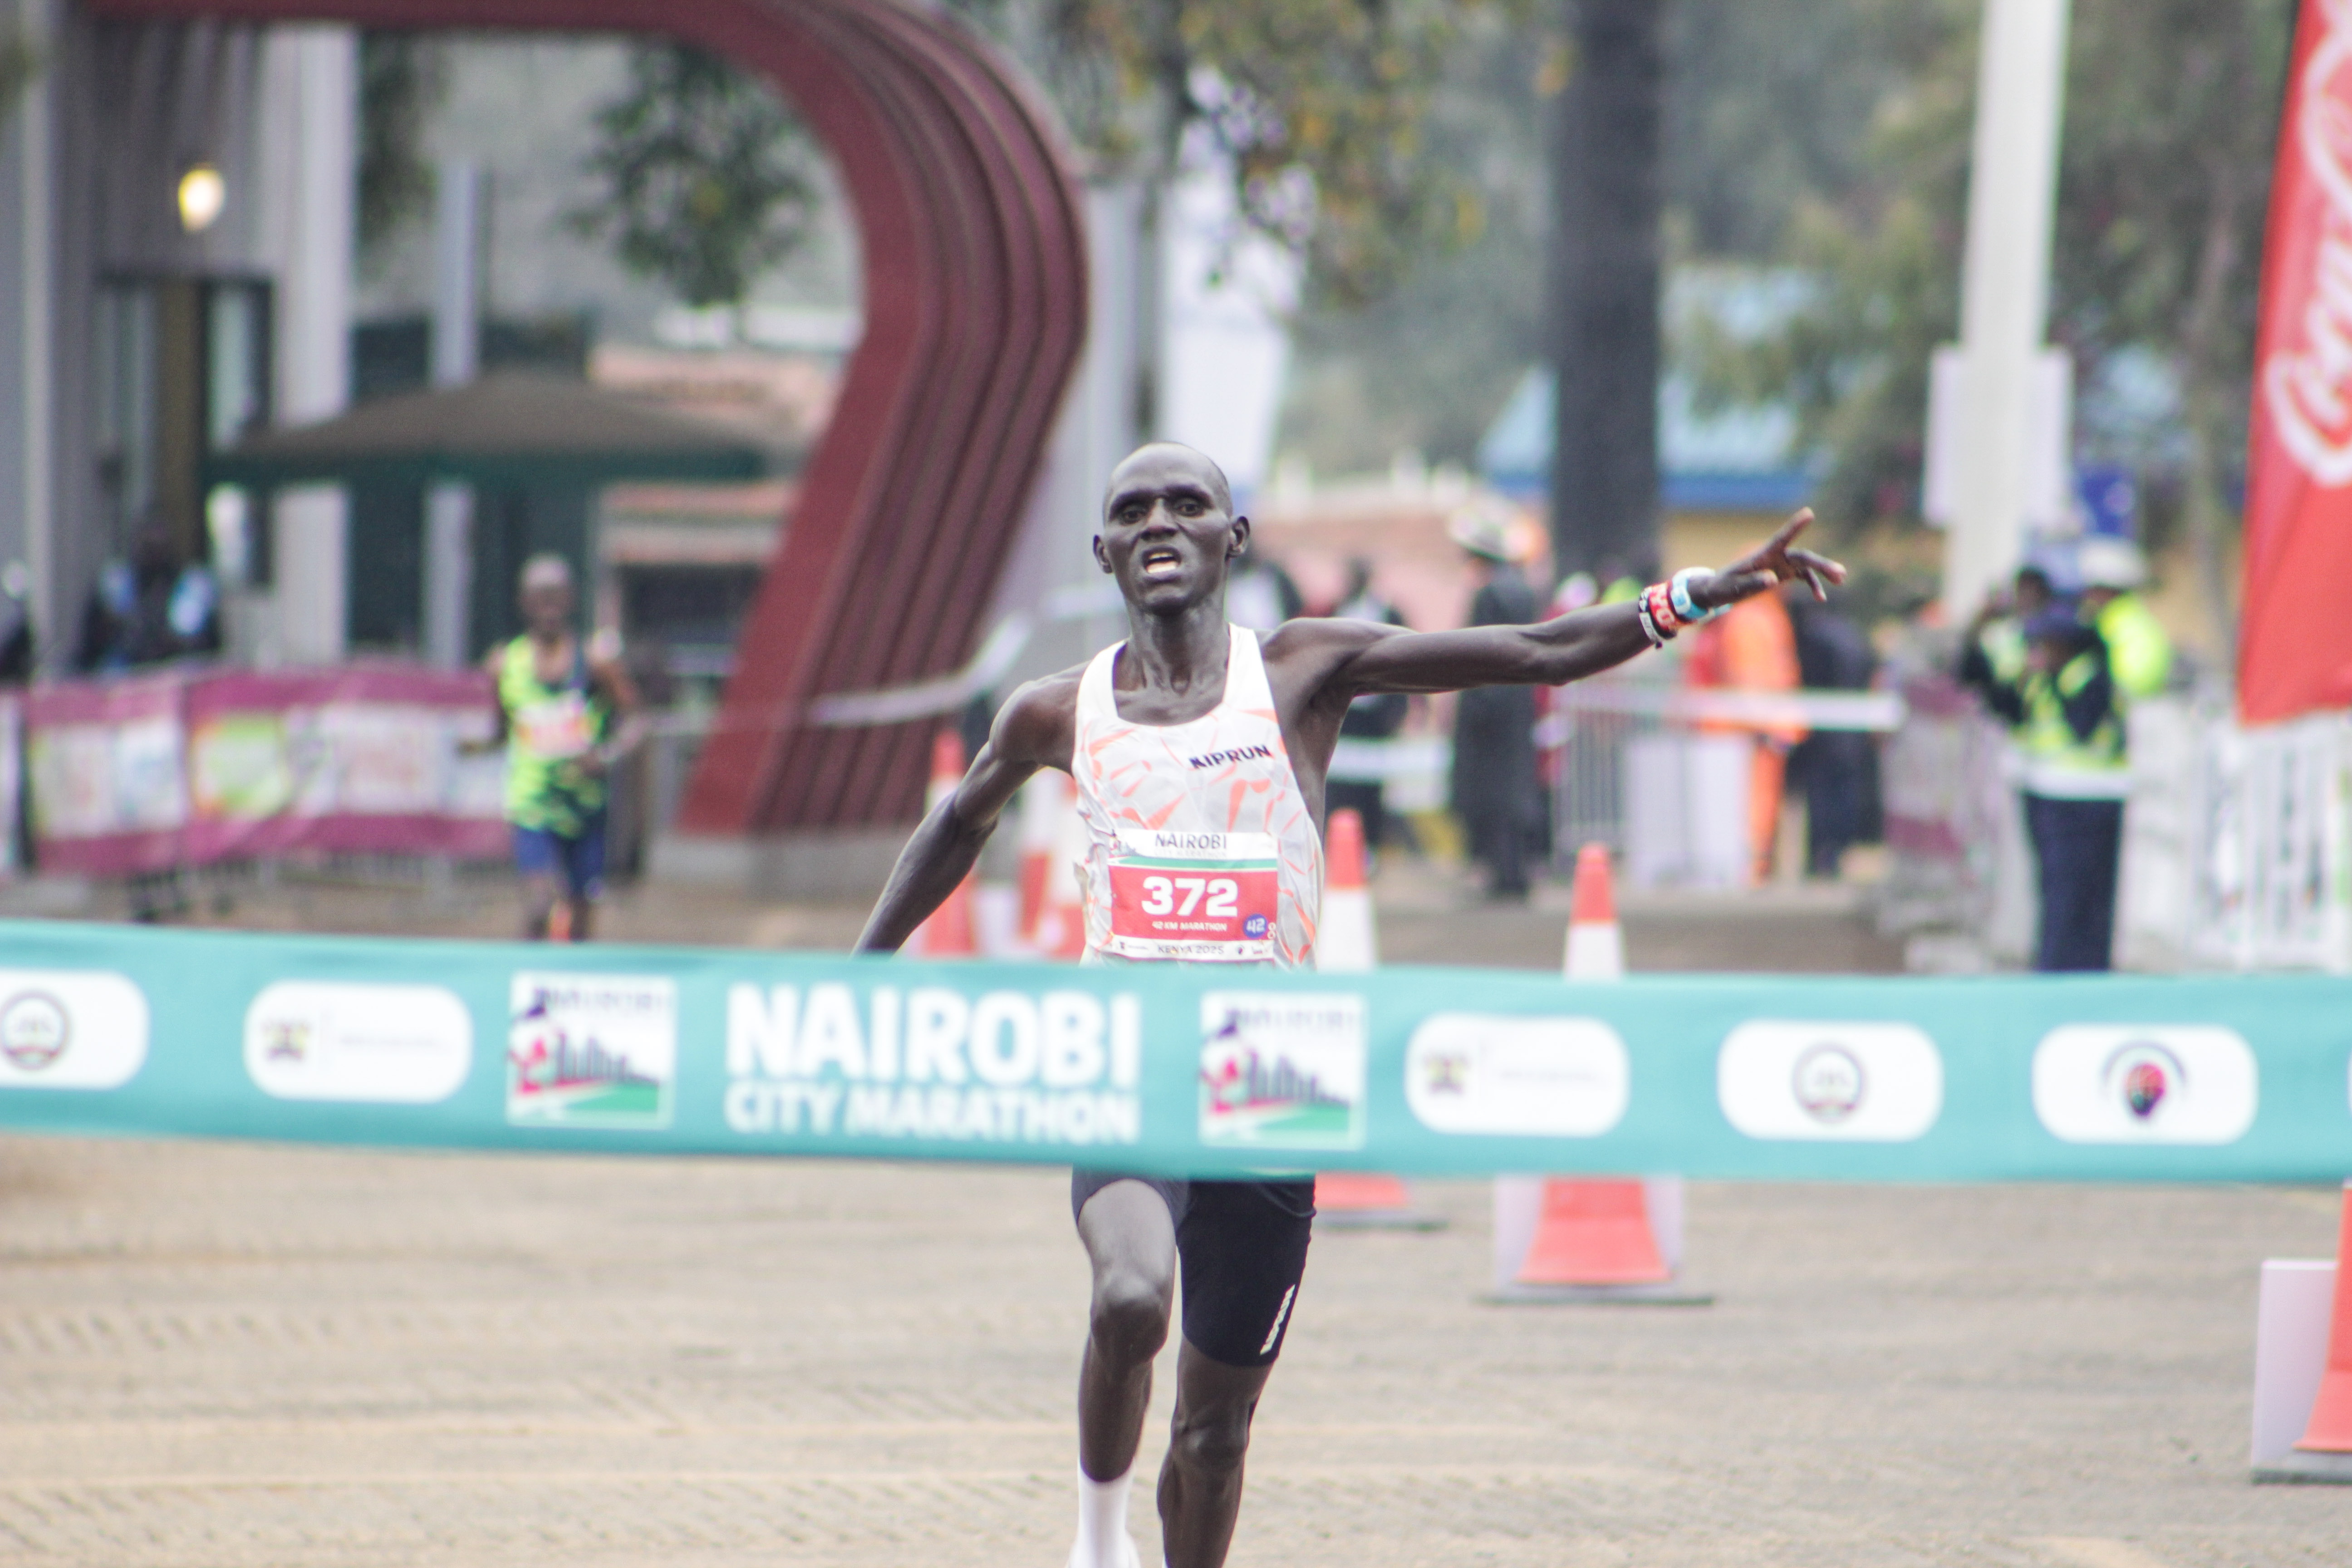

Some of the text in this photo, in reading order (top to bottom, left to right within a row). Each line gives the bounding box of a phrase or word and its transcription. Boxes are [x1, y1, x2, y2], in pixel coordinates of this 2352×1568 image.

[1188, 744, 1272, 770] KIPRUN
[1155, 833, 1227, 849] NAIROBI
[1141, 875, 1238, 917] 372
[1152, 921, 1228, 931] 42 KM MARATHON
[1246, 917, 1266, 934] 42
[1158, 945, 1192, 954] KENYA
[1196, 945, 1224, 954] 2025
[726, 982, 1141, 1088] NAIROBI
[725, 1080, 1140, 1145] CITY MARATHON
